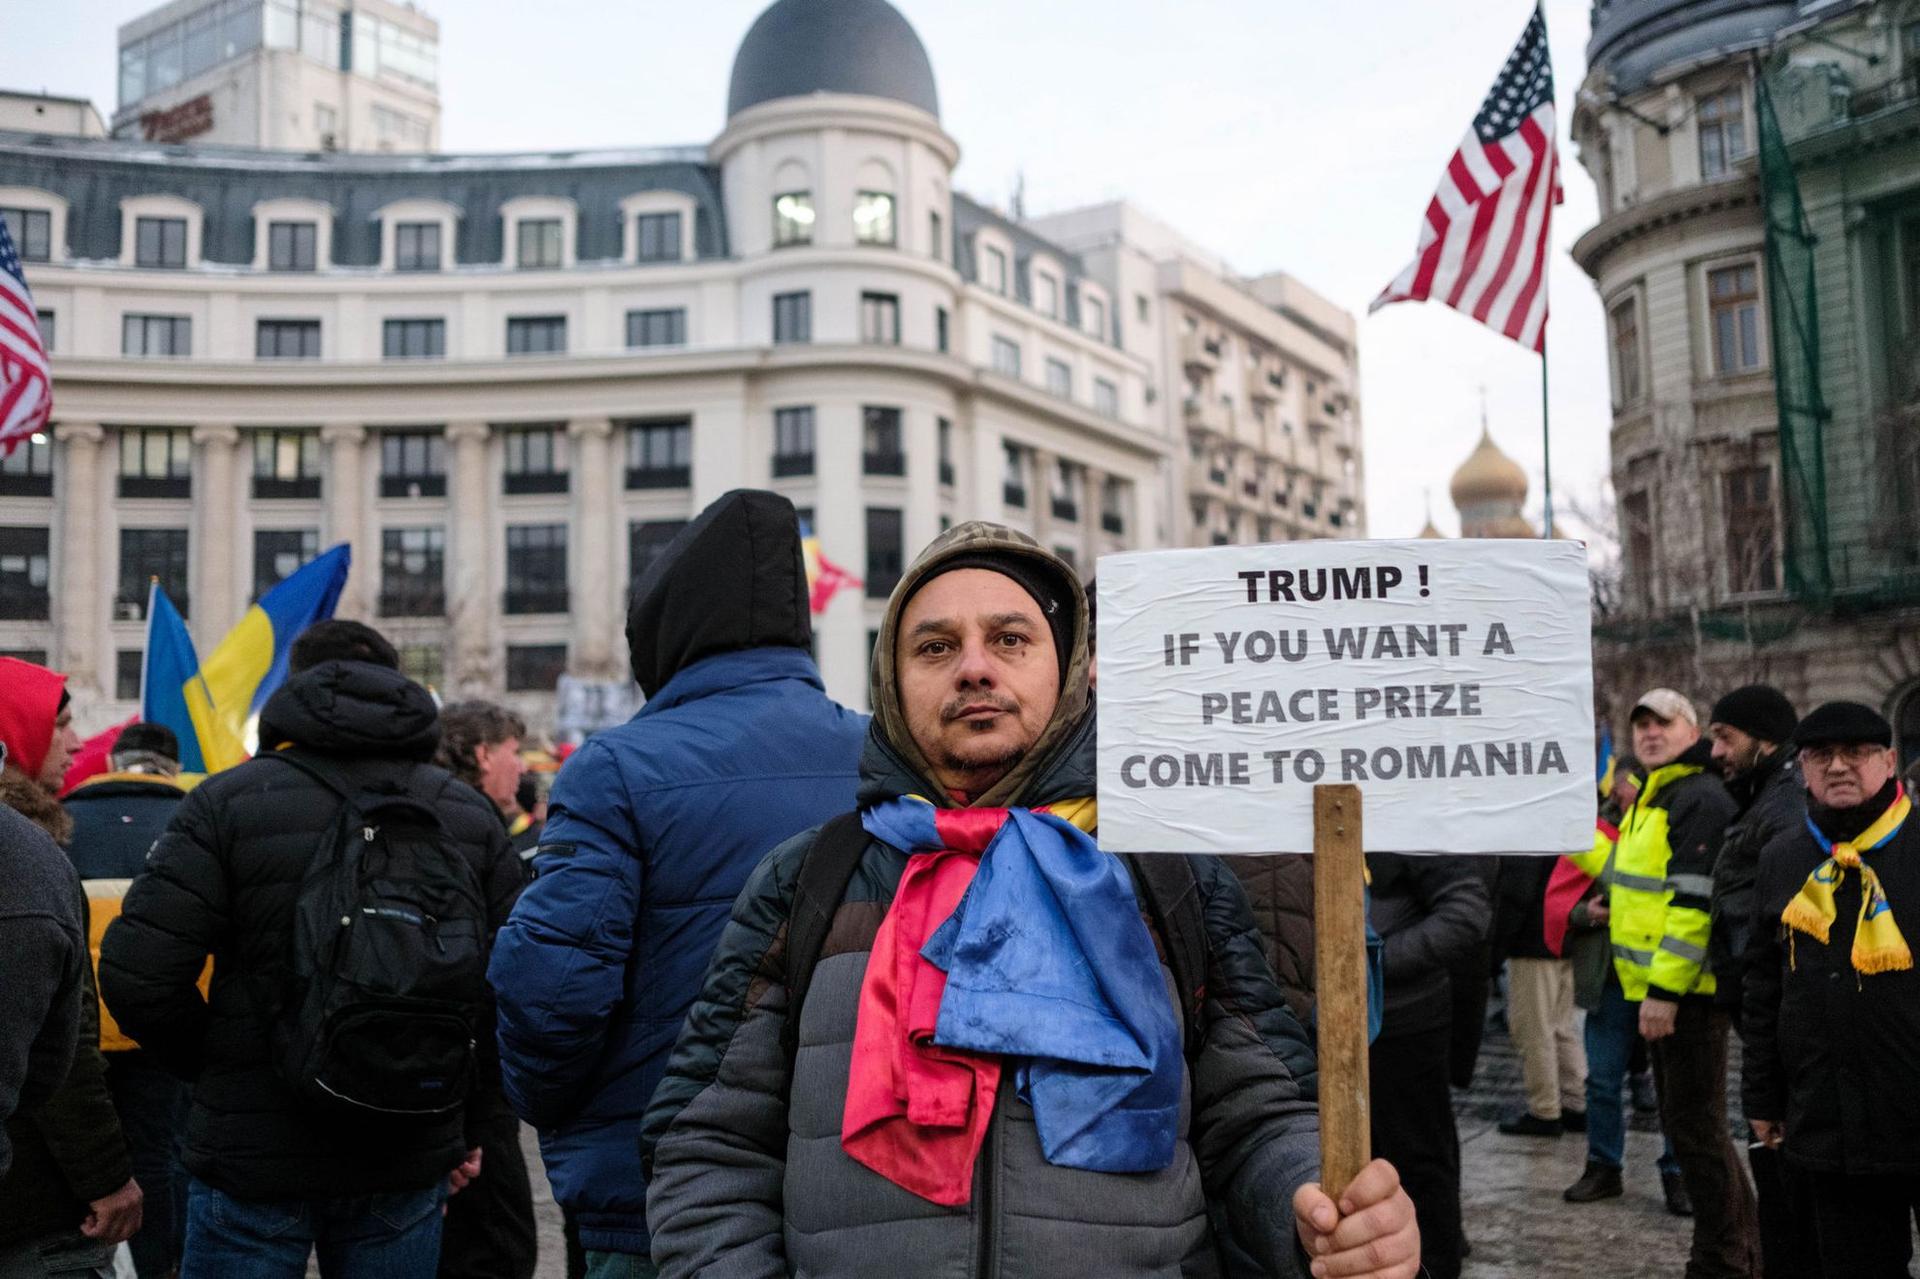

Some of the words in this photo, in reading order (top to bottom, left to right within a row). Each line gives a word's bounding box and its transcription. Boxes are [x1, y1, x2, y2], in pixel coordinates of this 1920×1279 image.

[1238, 566, 1402, 602] TRUMP
[1418, 565, 1430, 597] !
[1164, 634, 1199, 665] IF
[1215, 630, 1307, 663] YOU
[1323, 624, 1467, 660] WANT
[1483, 623, 1514, 655] A
[1202, 689, 1339, 724] PEACE
[1355, 684, 1481, 719] PRIZE
[1121, 753, 1250, 788] COME
[1264, 749, 1326, 783] TO
[1341, 741, 1569, 781] ROMANIA
